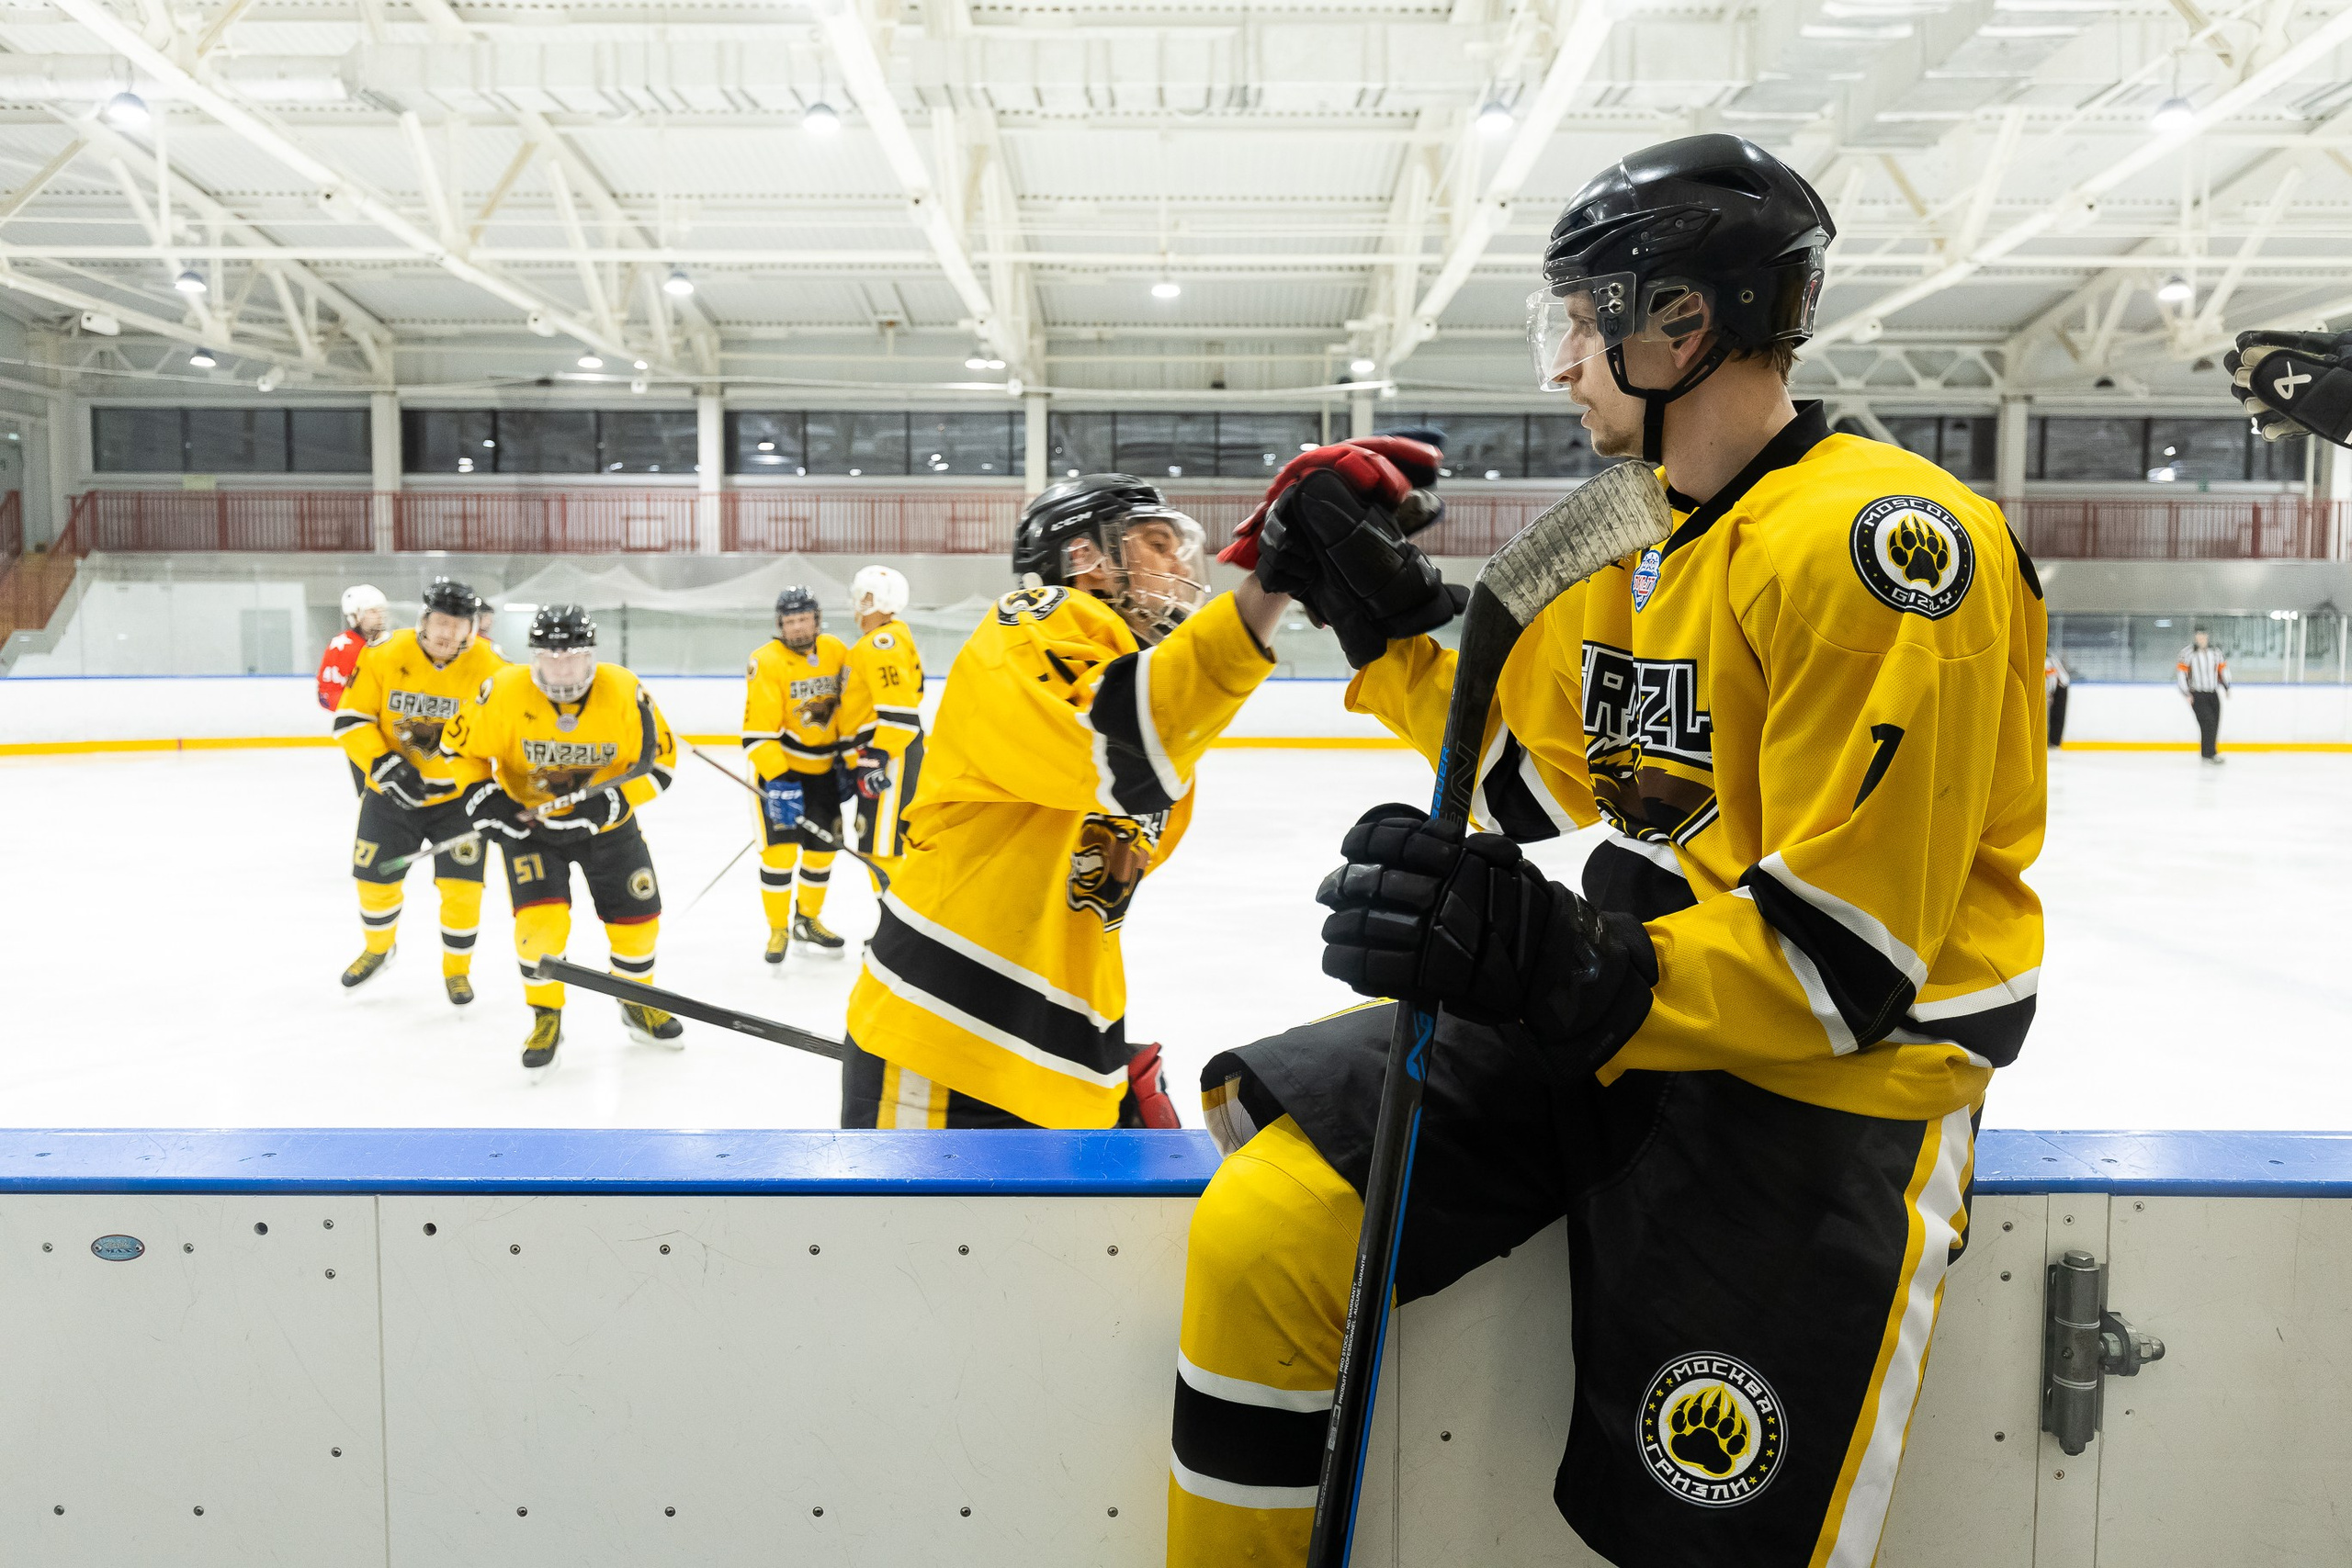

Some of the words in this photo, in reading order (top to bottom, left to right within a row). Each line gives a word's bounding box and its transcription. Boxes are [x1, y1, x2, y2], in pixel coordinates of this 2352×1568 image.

[1863, 499, 1960, 532] MOSCOW
[513, 852, 547, 885] 51
[1357, 1253, 1367, 1287] GARANTIE
[1353, 1288, 1362, 1315] AUCUNE
[1341, 1334, 1350, 1357] STOCK
[1348, 1281, 1357, 1318] WARRANTY
[1343, 1320, 1357, 1374] PROFESSIONNEL
[1338, 1374, 1348, 1404] PRODUIT
[1672, 1360, 1773, 1415] МОСКВА
[1645, 1442, 1750, 1499] ГРИЗЛИ
